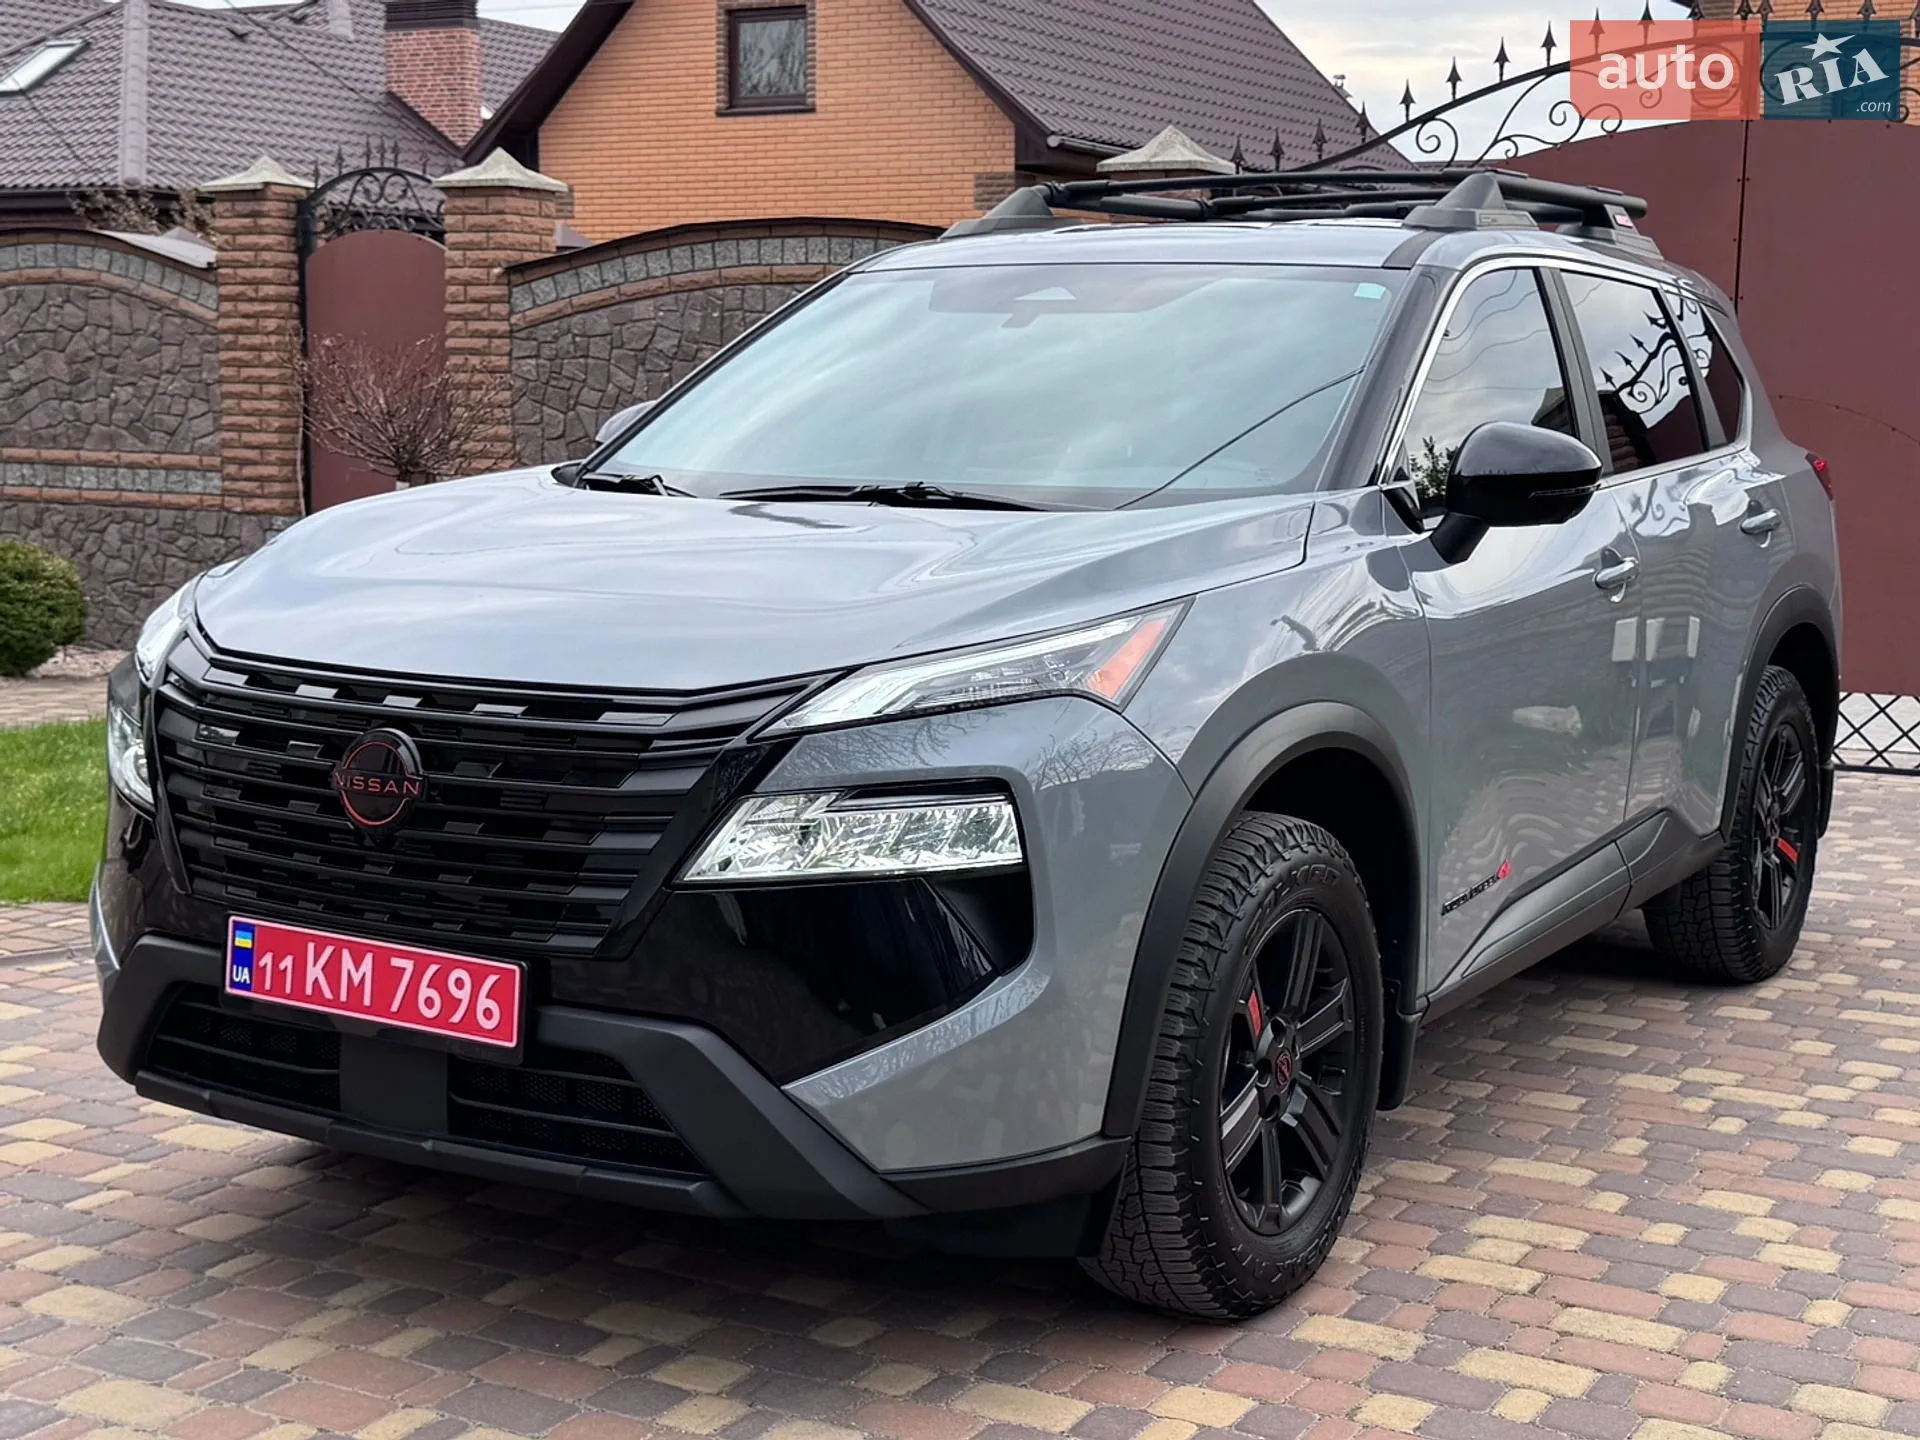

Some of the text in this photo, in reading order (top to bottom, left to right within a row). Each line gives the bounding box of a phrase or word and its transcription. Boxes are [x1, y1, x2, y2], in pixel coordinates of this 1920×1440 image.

[334, 771, 420, 796] NISSAN
[232, 964, 251, 984] UA
[389, 956, 502, 1031] 7696
